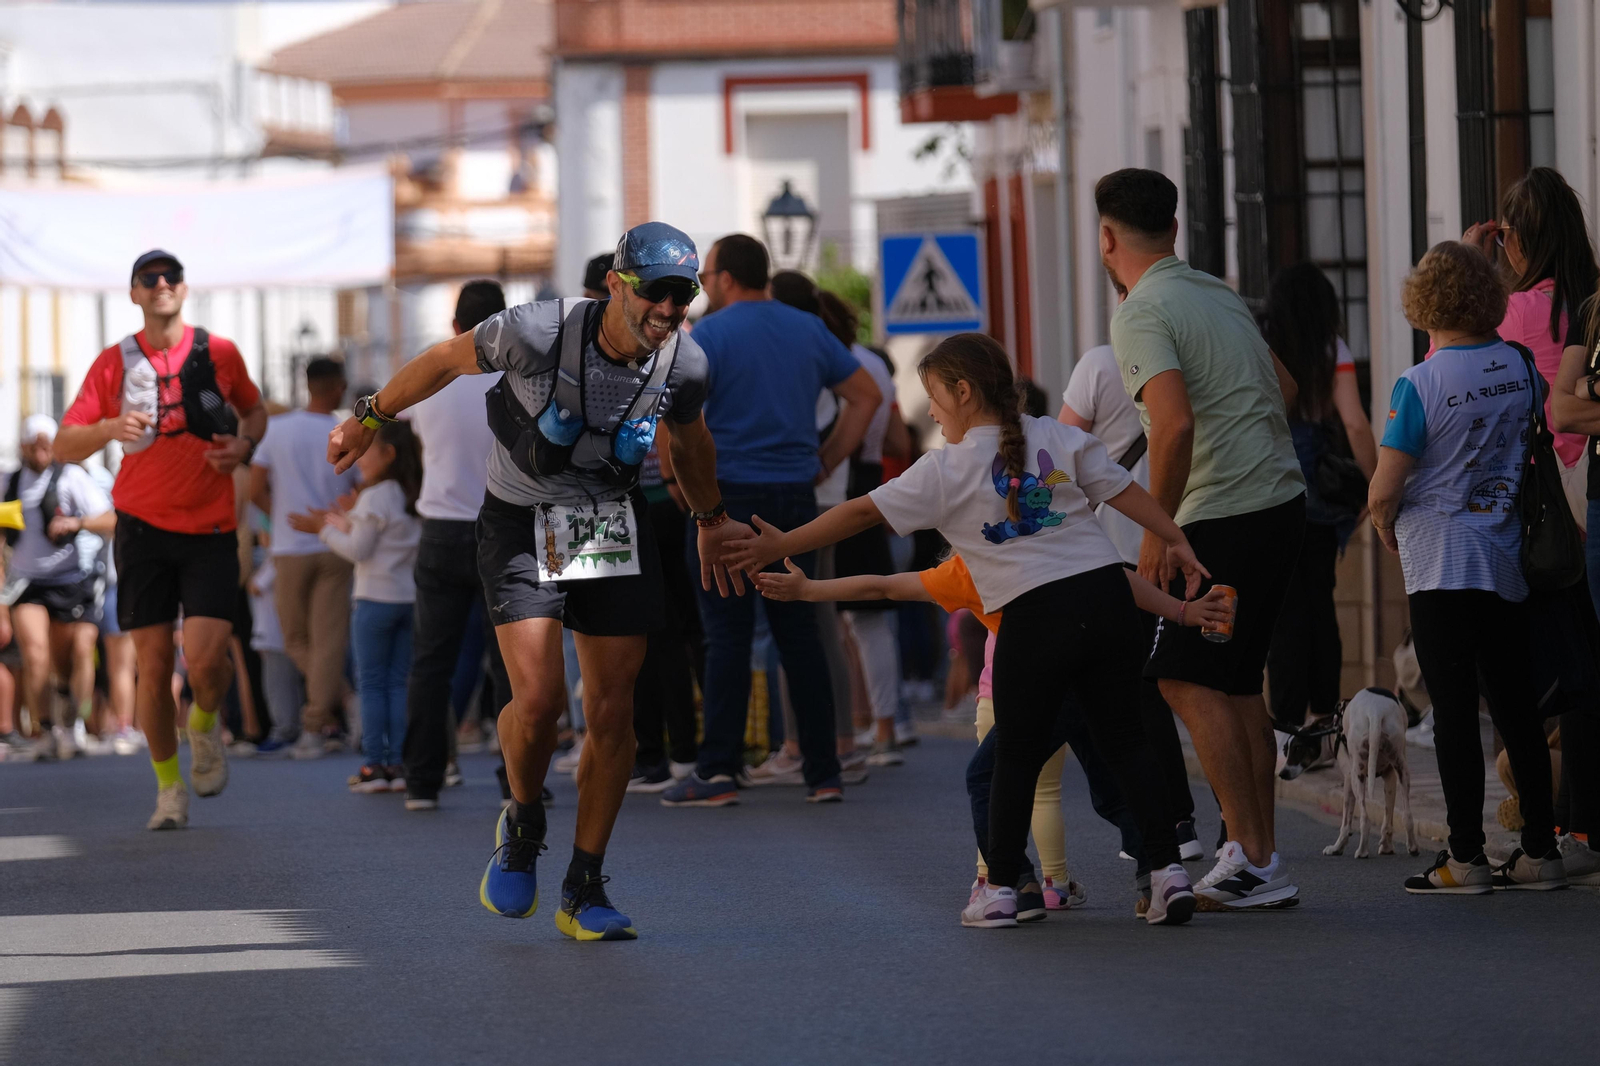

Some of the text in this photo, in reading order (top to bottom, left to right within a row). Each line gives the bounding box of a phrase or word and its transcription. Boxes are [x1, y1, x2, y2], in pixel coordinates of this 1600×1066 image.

[1447, 395, 1462, 408] C.
[1465, 391, 1478, 403] A.
[568, 515, 630, 542] 1173
